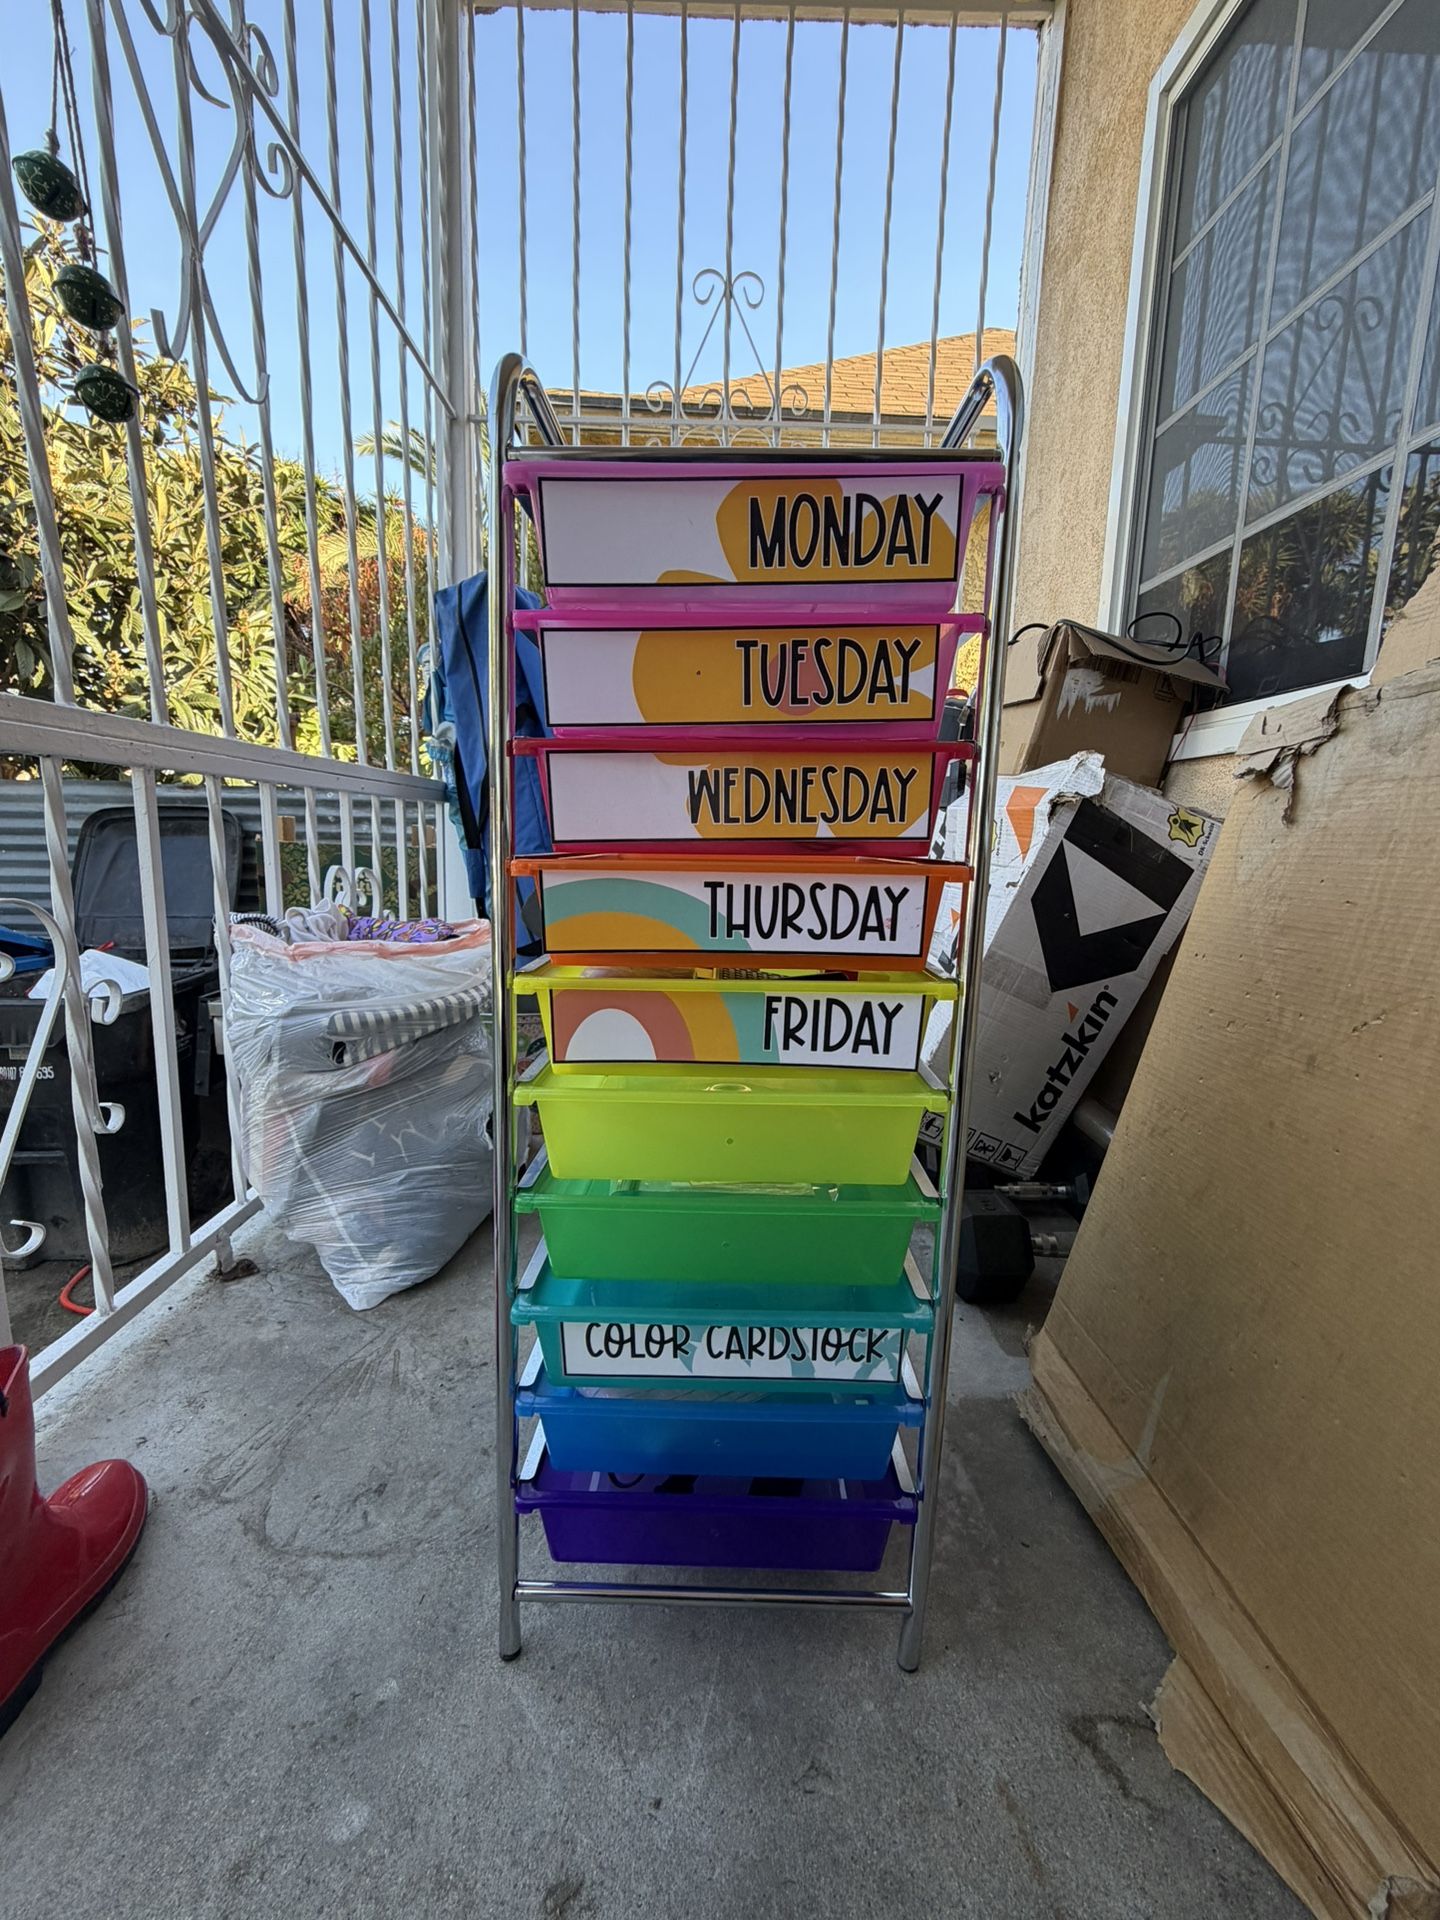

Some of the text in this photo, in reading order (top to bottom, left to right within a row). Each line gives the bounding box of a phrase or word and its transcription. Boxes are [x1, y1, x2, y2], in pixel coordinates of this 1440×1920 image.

[750, 493, 943, 568] MONDAY
[736, 638, 921, 706] TUESDAY
[688, 766, 917, 823] WEDNESDAY
[704, 881, 909, 942] THURSDAY
[764, 996, 904, 1055] FRIDAY
[1013, 990, 1119, 1134] katzkin
[585, 1323, 690, 1358] COLOR
